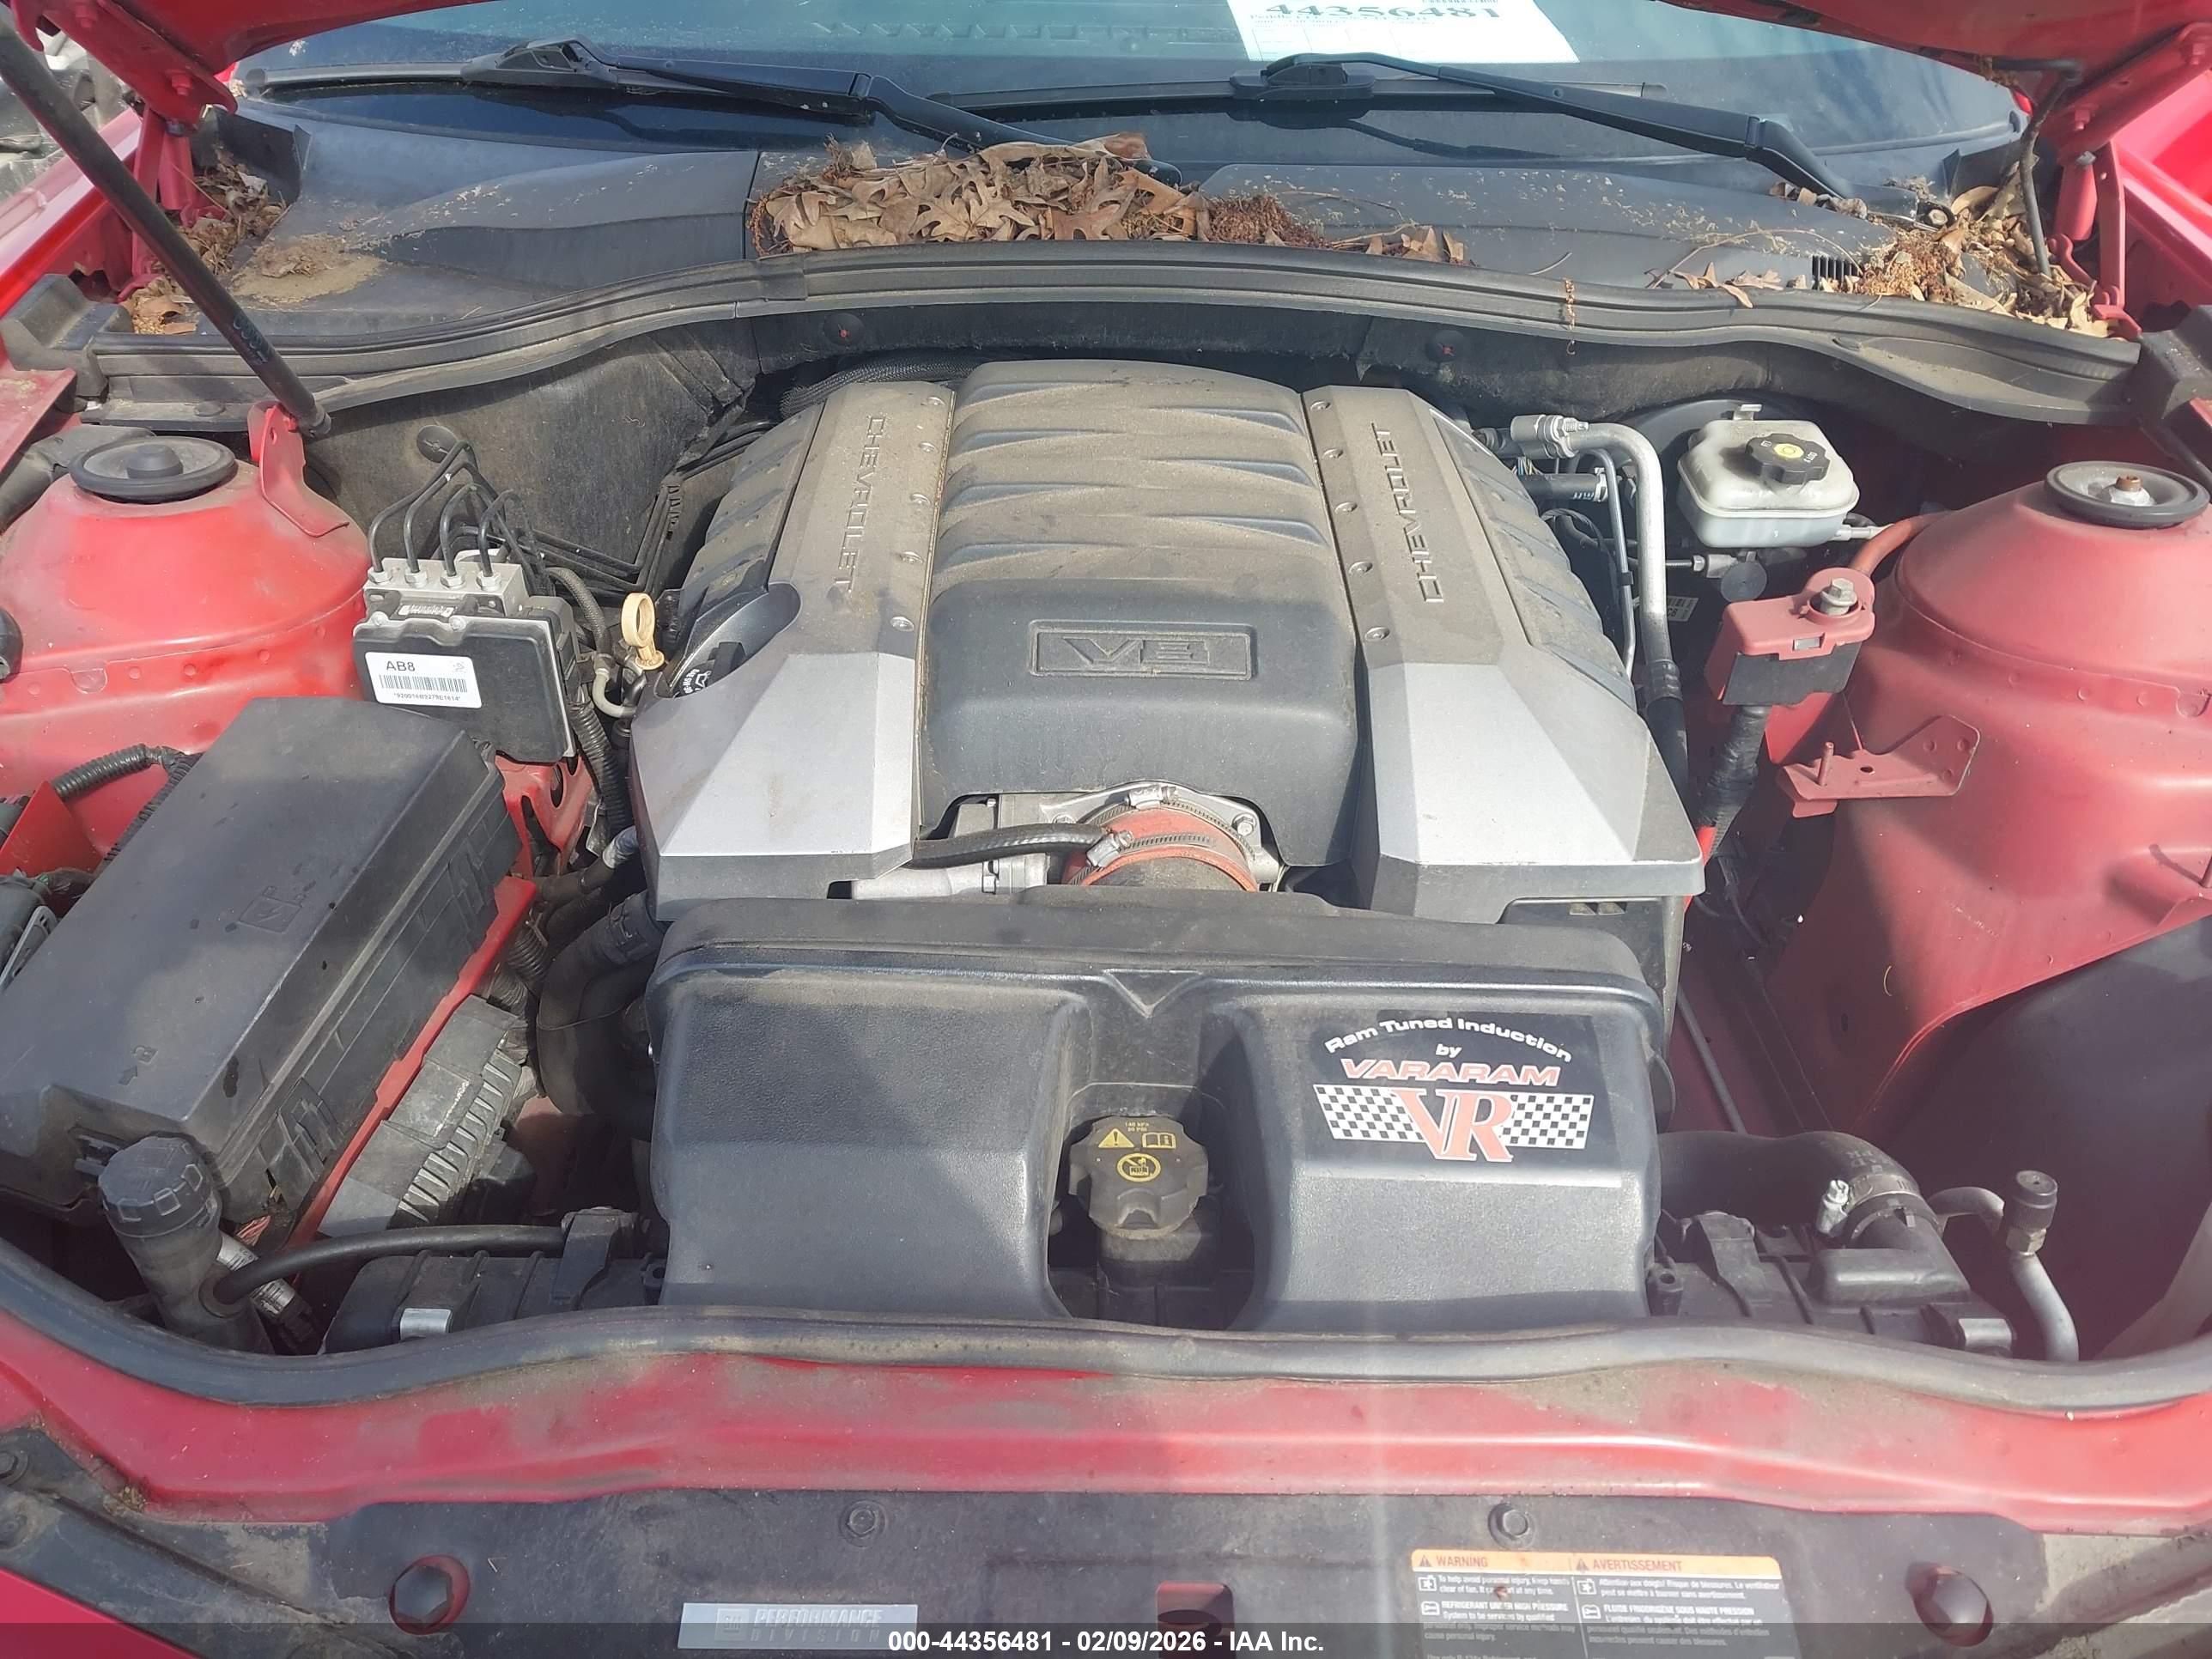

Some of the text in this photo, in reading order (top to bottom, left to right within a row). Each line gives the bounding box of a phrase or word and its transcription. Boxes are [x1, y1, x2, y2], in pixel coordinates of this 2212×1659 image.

[1266, 4, 1500, 18] 44356481
[835, 416, 886, 593] CHEVROLET
[1371, 422, 1444, 603] CHEVROLET
[1062, 636, 1210, 669] V8
[386, 660, 416, 672] AB8
[1324, 1018, 1573, 1063] Ram Tuned Induction
[1435, 1043, 1462, 1059] by
[1340, 1058, 1561, 1087] VARARAM
[1390, 1086, 1515, 1163] VR
[1437, 1555, 1489, 1568] WARNING
[1593, 1559, 1683, 1571] AVERTISSEMENT
[753, 1608, 884, 1628] PERFORMANCE
[750, 1628, 880, 1643] DIVISION
